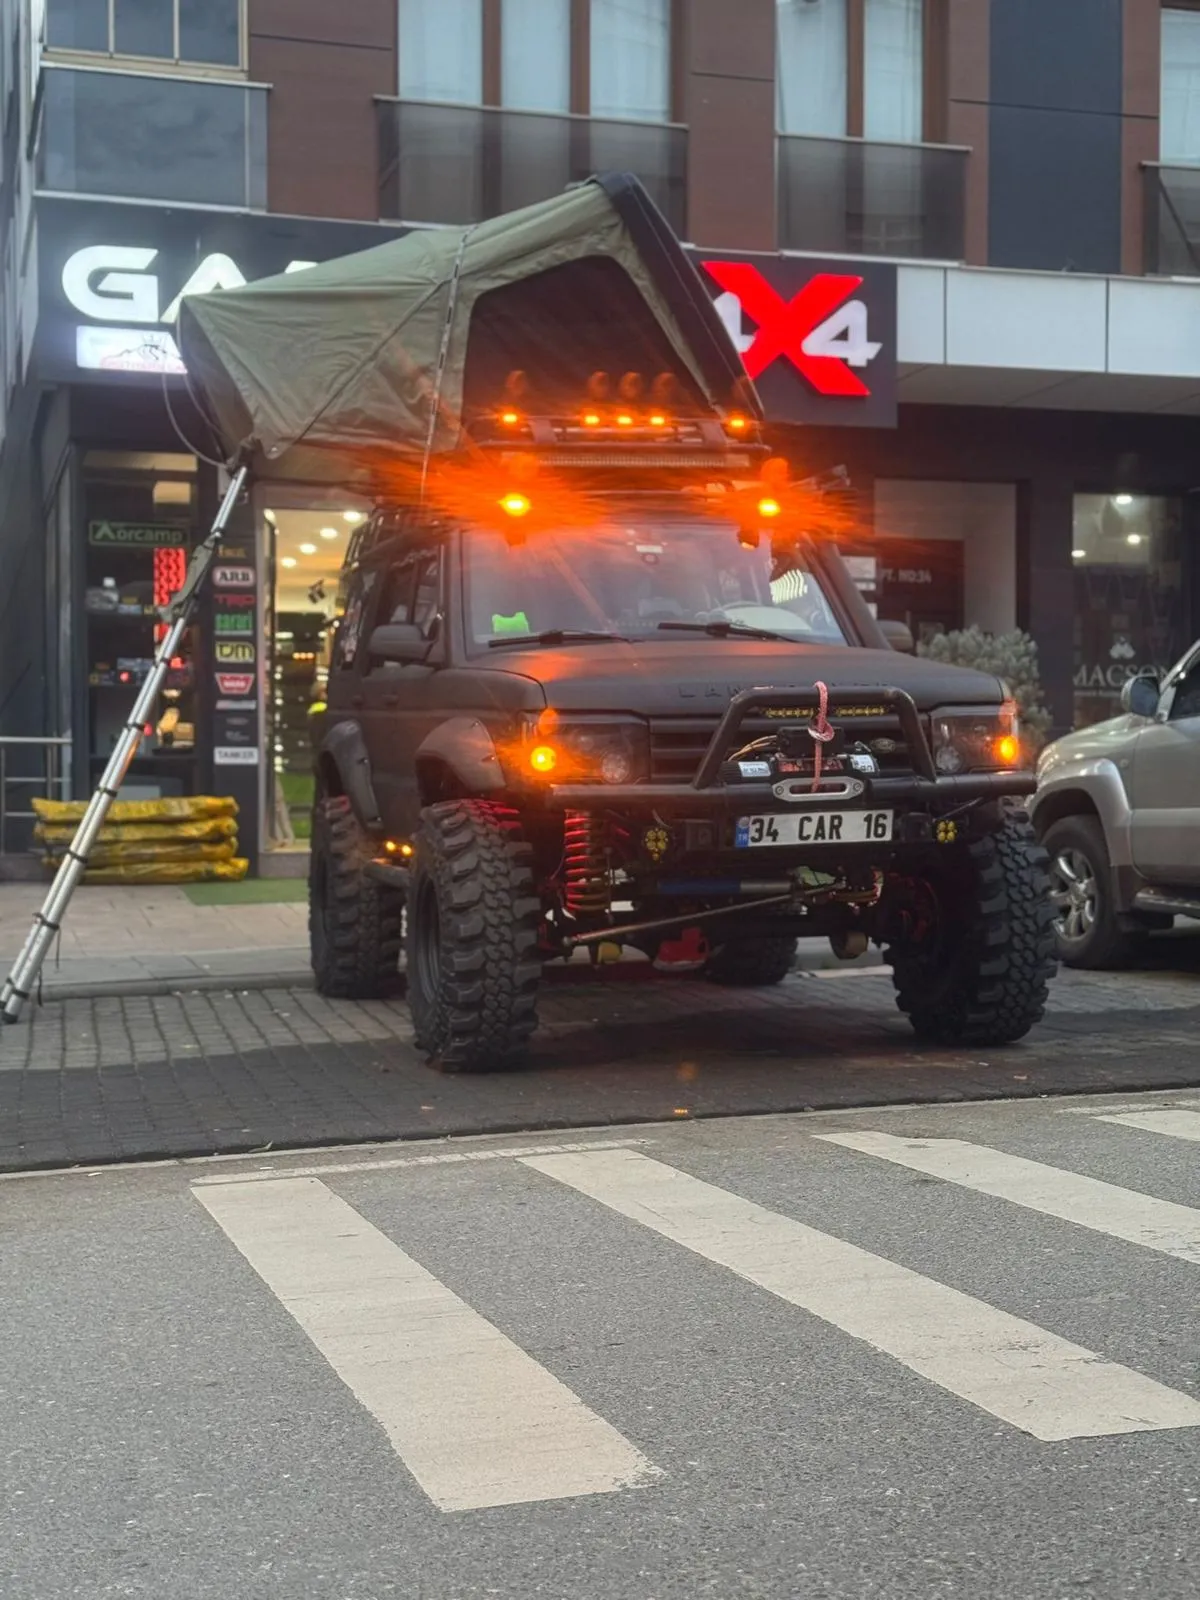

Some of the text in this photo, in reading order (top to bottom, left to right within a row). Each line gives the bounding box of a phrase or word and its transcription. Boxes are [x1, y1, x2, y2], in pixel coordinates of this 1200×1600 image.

[219, 570, 250, 582] ARB
[750, 813, 888, 843] 34 CAR 16
